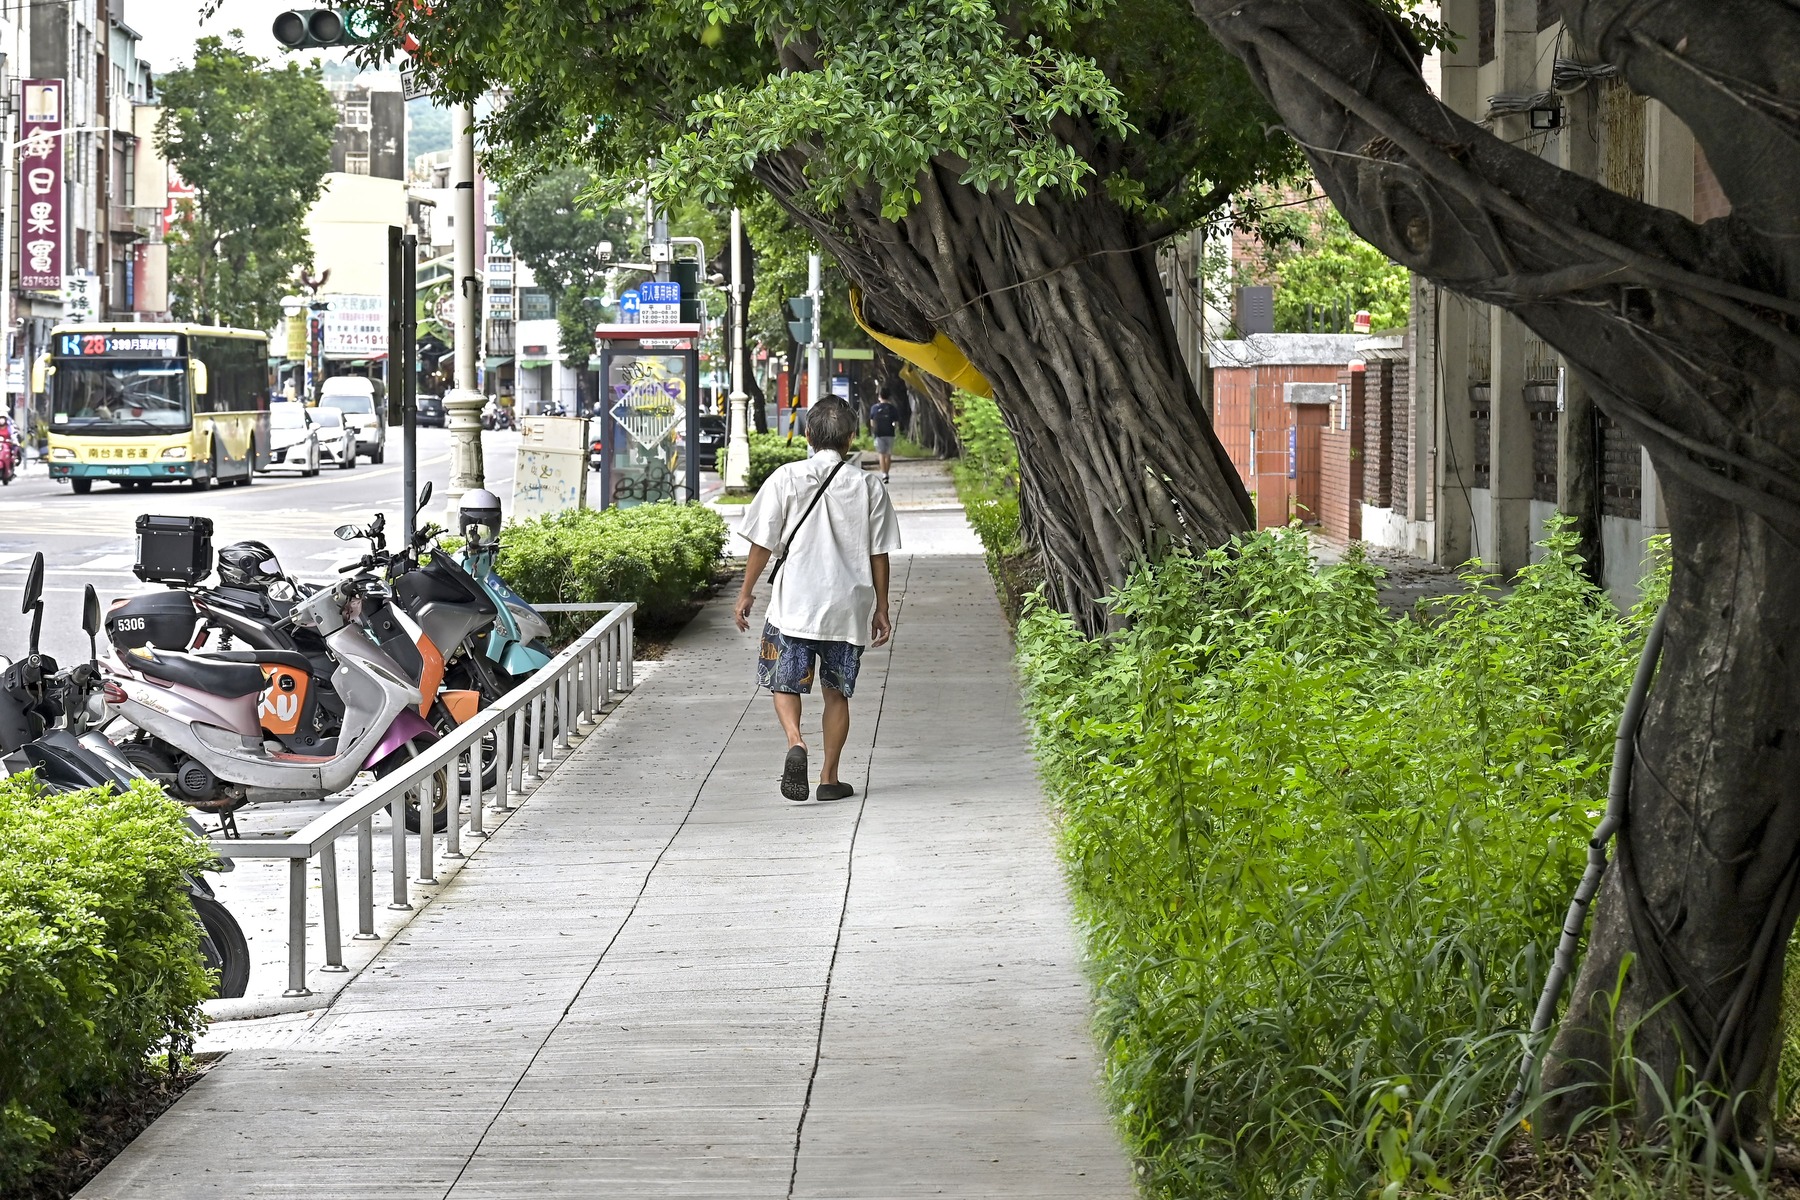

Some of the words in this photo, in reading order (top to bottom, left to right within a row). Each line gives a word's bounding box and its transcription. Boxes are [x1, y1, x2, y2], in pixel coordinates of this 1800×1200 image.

[642, 285, 678, 301] 行人專用時相
[83, 335, 106, 355] 28
[88, 448, 149, 459] 南台灣客運
[118, 617, 145, 632] 5306
